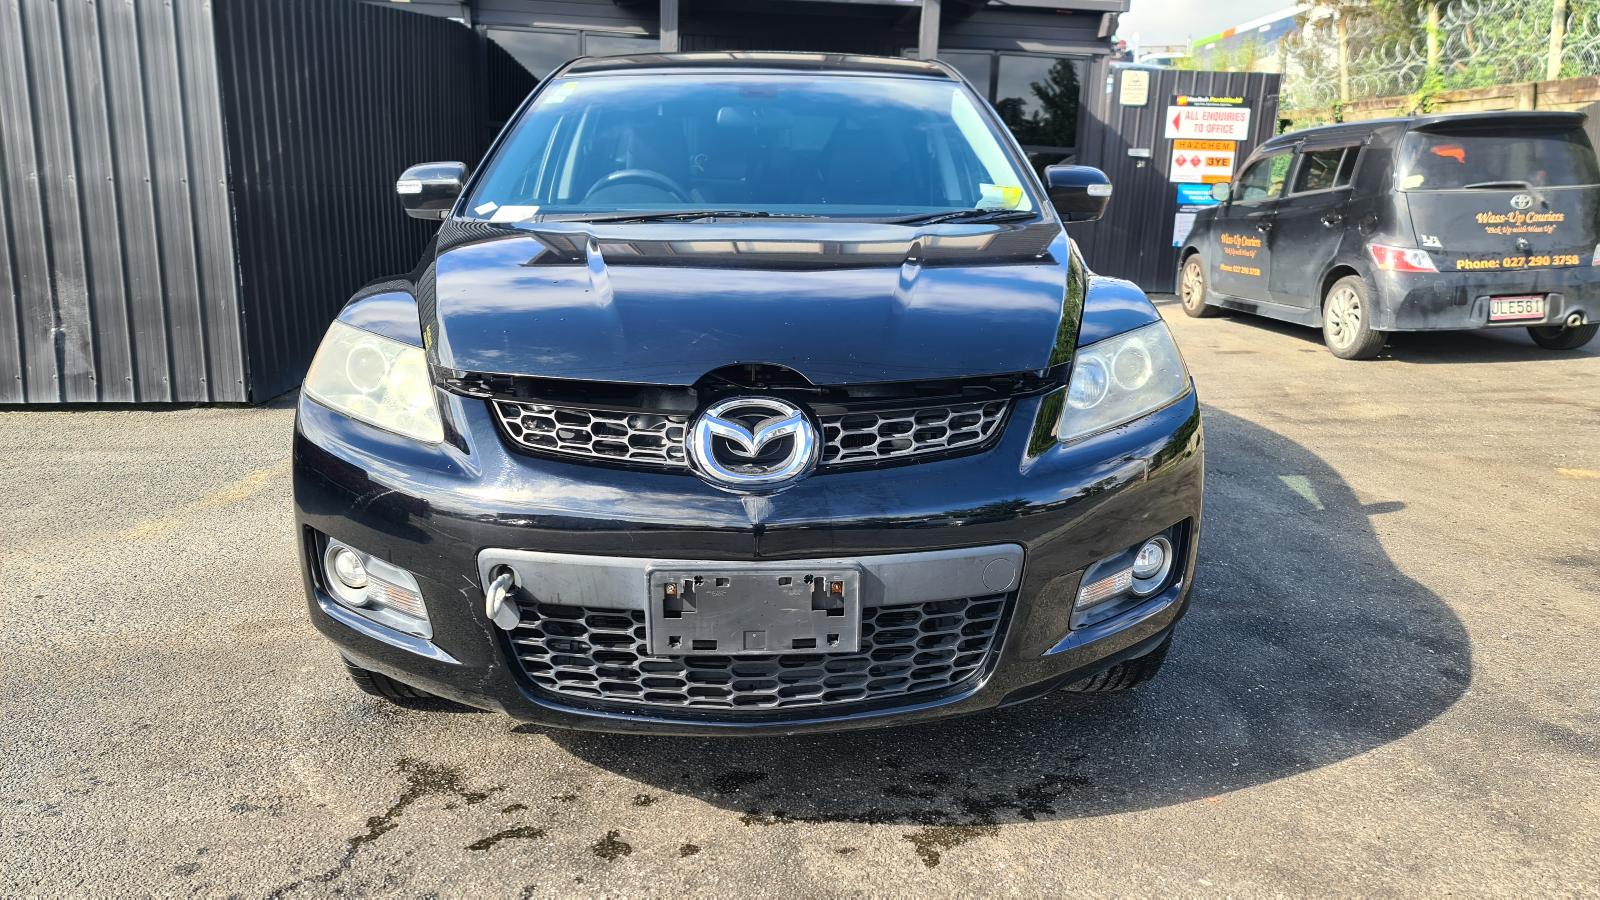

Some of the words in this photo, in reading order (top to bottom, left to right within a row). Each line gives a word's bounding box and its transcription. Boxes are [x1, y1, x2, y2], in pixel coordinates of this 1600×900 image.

[1185, 111, 1199, 120] ALL
[1202, 111, 1246, 122] ENQUIRIES
[1194, 123, 1204, 133] TO
[1206, 124, 1234, 133] OFFICE
[1179, 142, 1230, 150] HAZCHEM
[1207, 157, 1228, 166] 3YE
[1475, 210, 1525, 225] Wass-Up
[1526, 211, 1565, 223] Couriers
[1456, 259, 1500, 270] Phone:
[1503, 257, 1526, 268] 027
[1528, 255, 1551, 266] 290
[1552, 255, 1580, 265] 3758
